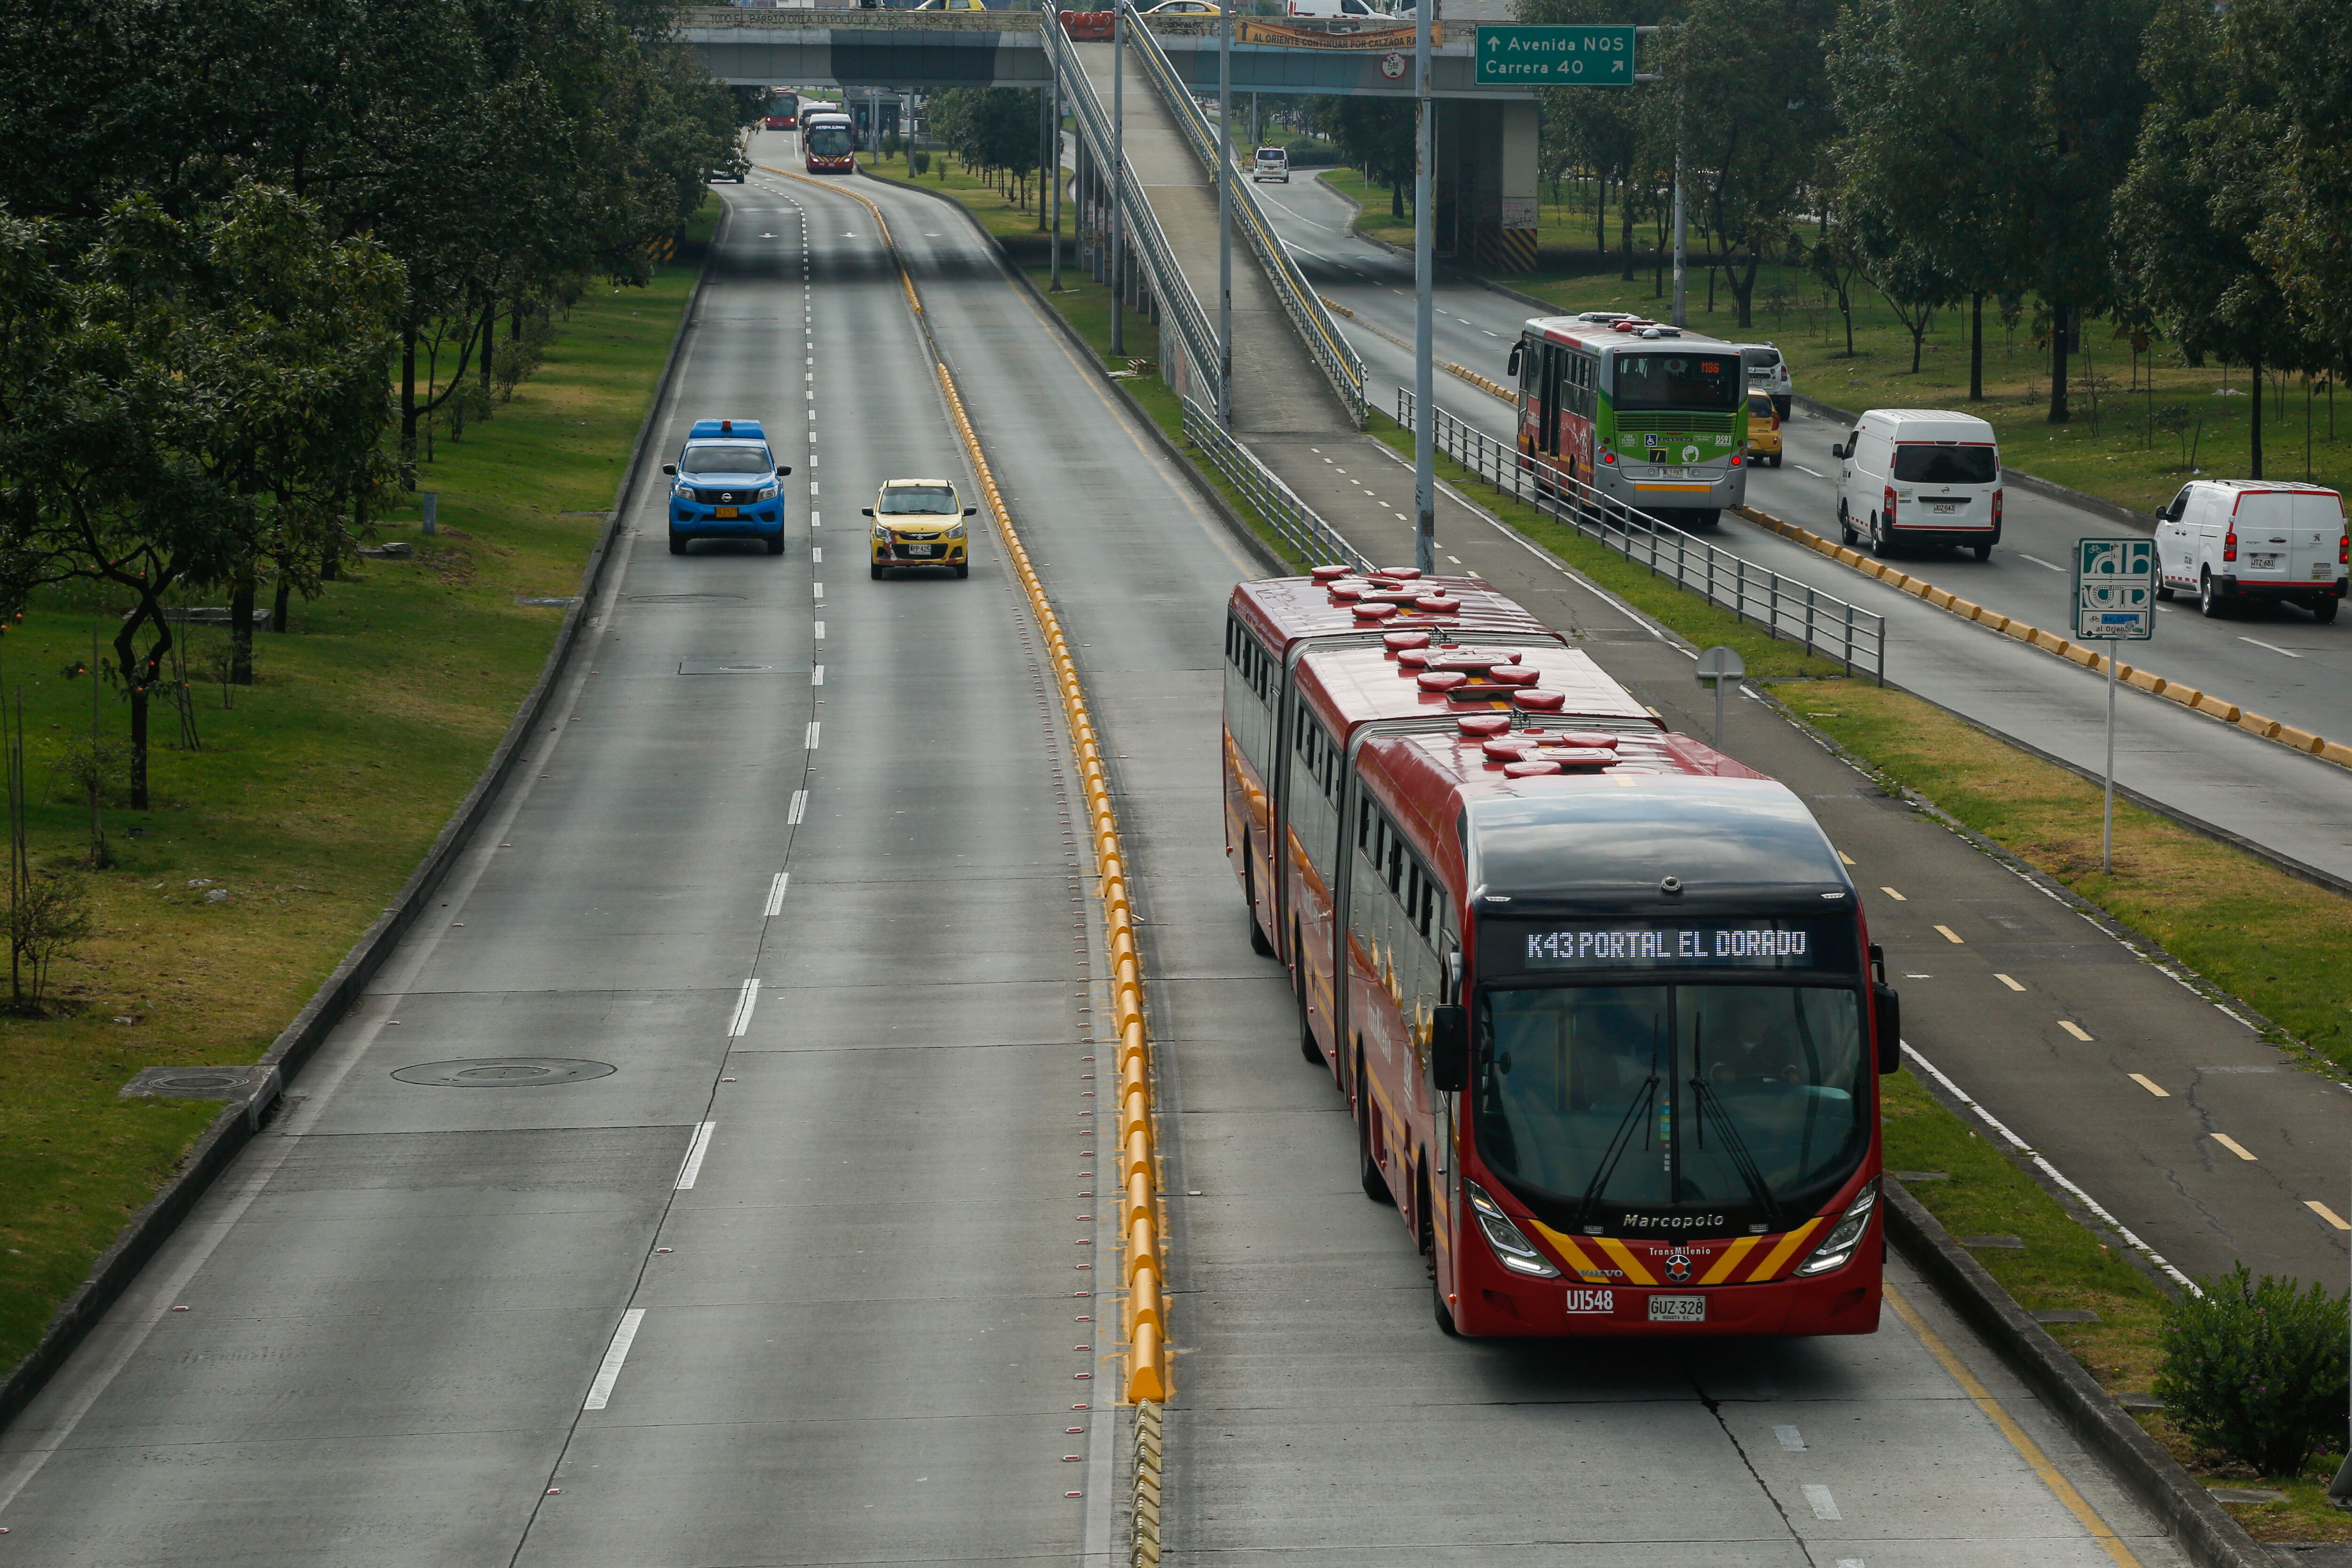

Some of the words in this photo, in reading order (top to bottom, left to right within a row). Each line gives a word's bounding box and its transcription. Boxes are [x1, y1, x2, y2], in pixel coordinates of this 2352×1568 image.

[709, 14, 731, 24] TODO
[749, 15, 785, 24] BARRIO
[1253, 33, 1263, 42] AL
[1266, 34, 1299, 46] ORIENTE
[1302, 38, 1348, 48] CONTINUAR
[1368, 37, 1404, 47] CALZADA
[1406, 36, 1435, 46] RAA
[1508, 37, 1575, 51] Avenida
[1584, 37, 1624, 51] NQS
[1486, 60, 1549, 74] Carrera
[1557, 60, 1583, 74] 40
[1701, 362, 1719, 373] M86
[1528, 932, 1574, 958] K43
[1578, 932, 1671, 958] PORTAL
[1678, 931, 1708, 958] EL
[1716, 930, 1806, 957] DORADO
[1623, 1214, 1724, 1228] Marcopolo
[1649, 1247, 1710, 1255] TransMilenio
[1566, 1290, 1613, 1310] U1548
